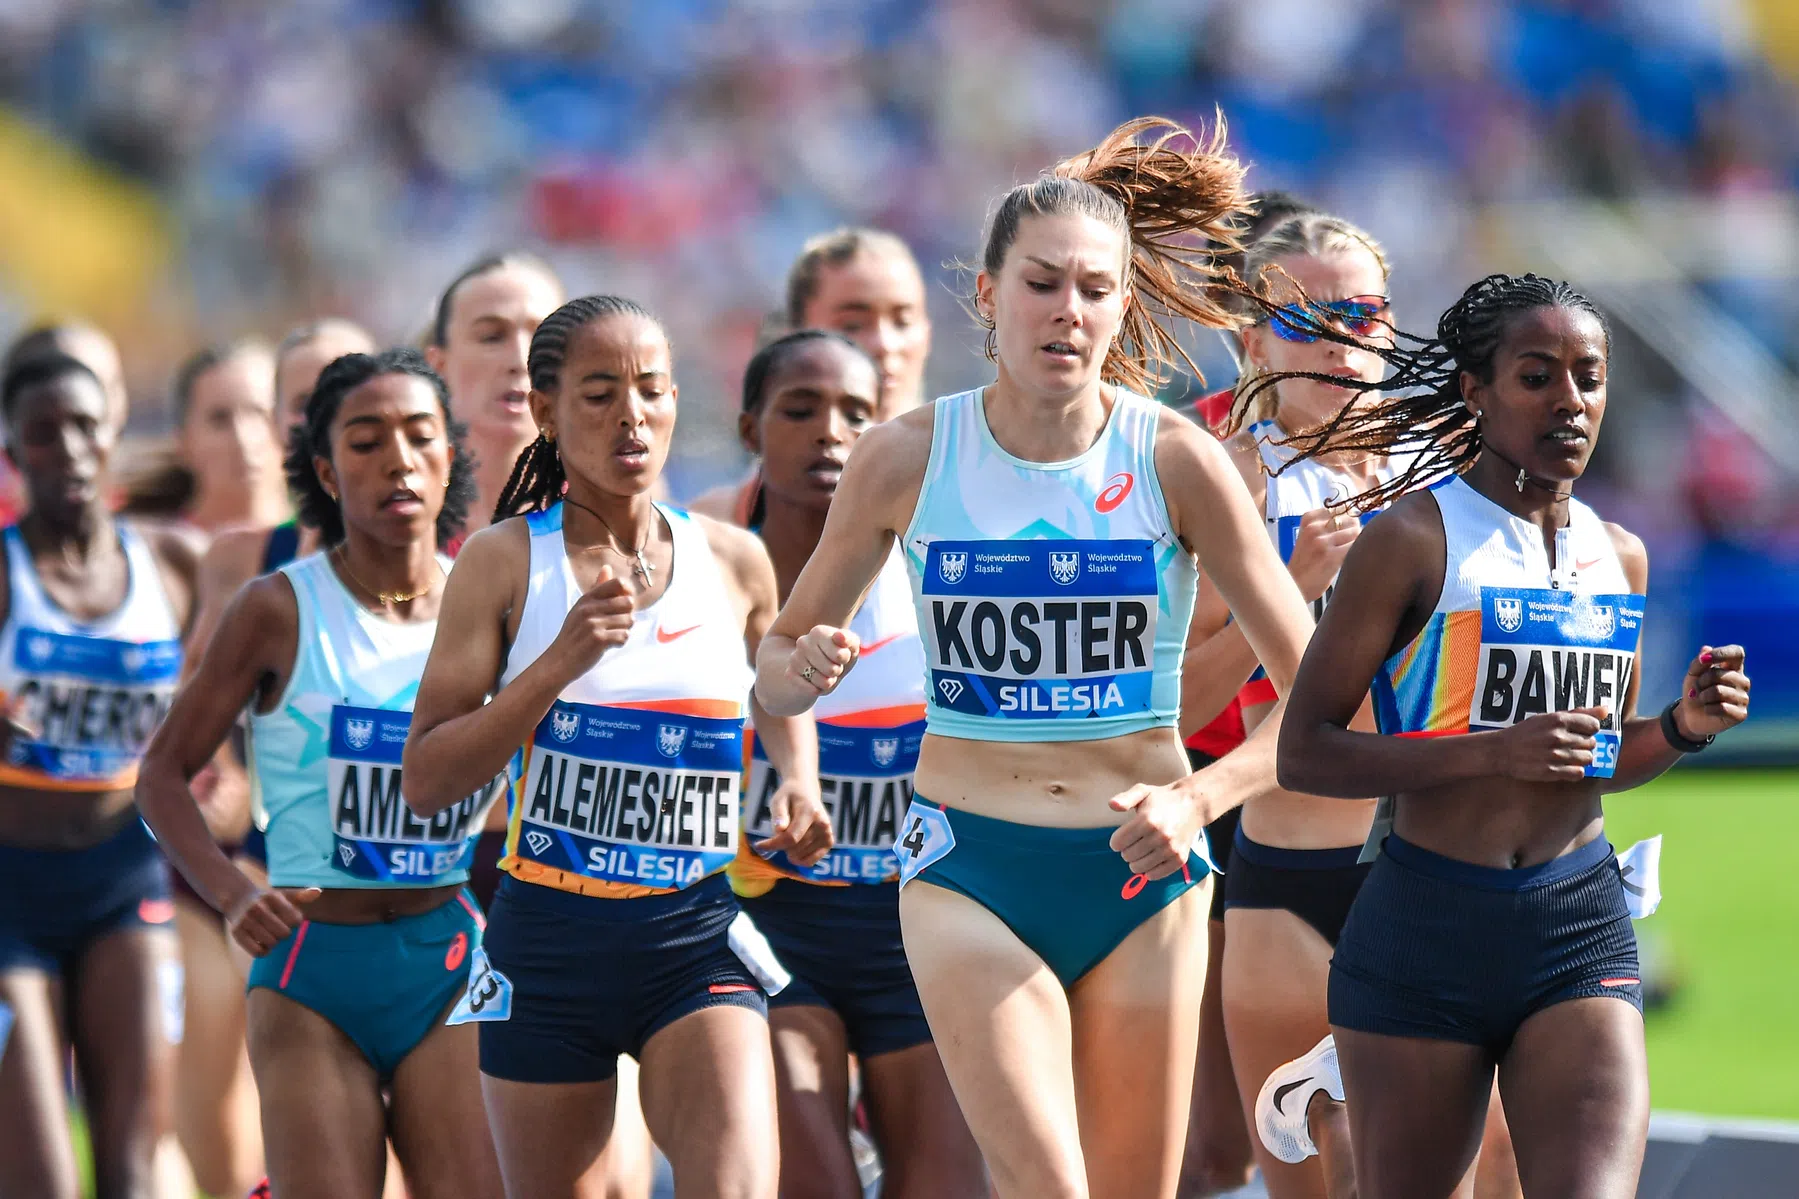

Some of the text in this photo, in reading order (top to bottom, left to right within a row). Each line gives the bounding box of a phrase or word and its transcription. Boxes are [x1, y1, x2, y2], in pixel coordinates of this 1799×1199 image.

[974, 553, 1031, 564] Województwo
[974, 563, 1003, 574] Śląskie
[1087, 553, 1143, 564] Województwo
[1087, 563, 1117, 574] Śląskie
[932, 601, 1148, 675] KOSTER
[1000, 683, 1125, 712] SILESIA
[529, 754, 731, 848] ALEMESHETE
[903, 817, 923, 858] 4
[587, 846, 705, 883] SILESIA
